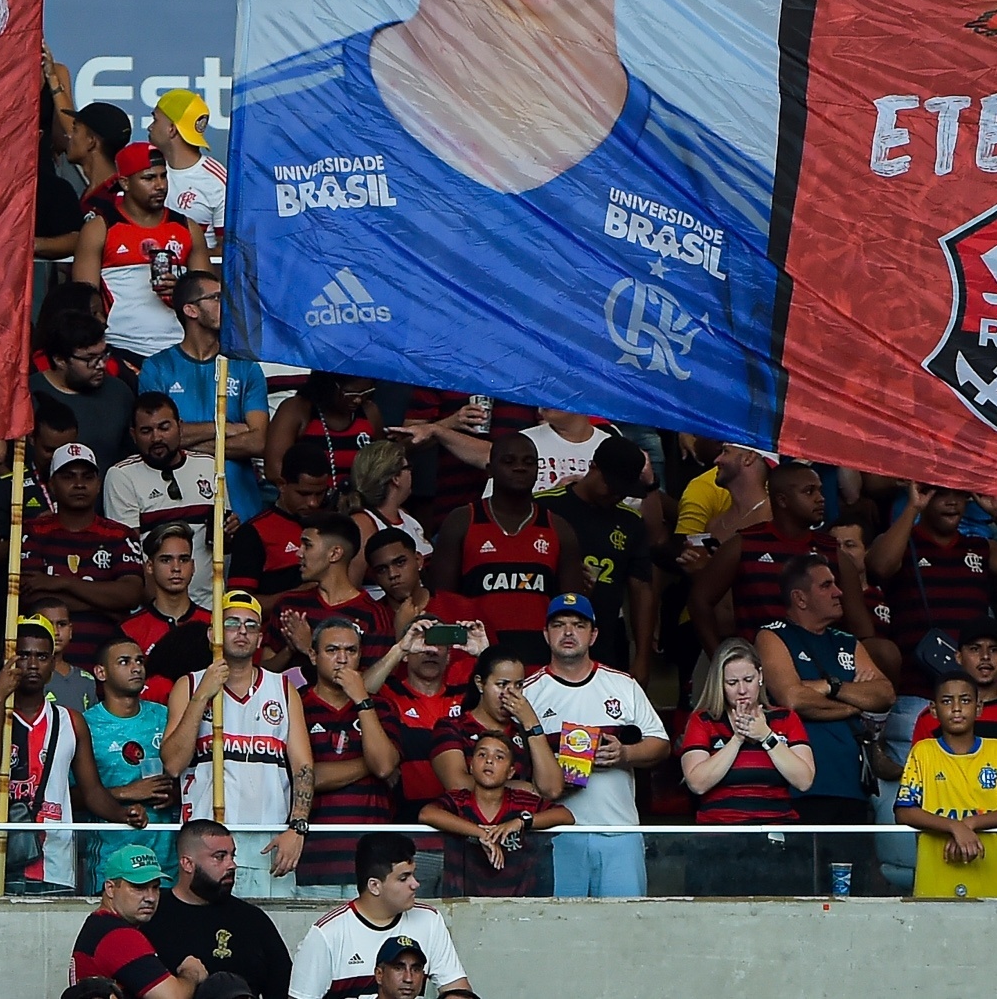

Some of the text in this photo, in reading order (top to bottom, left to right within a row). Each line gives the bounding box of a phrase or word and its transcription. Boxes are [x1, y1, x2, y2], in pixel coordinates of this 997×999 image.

[273, 155, 385, 182] UNIVERSIDADE
[276, 173, 397, 218] BRASIL
[608, 186, 724, 245] UNIVERSIDADE
[603, 203, 727, 282] BRASIL
[304, 304, 393, 327] adidas
[482, 572, 545, 593] CAIXA
